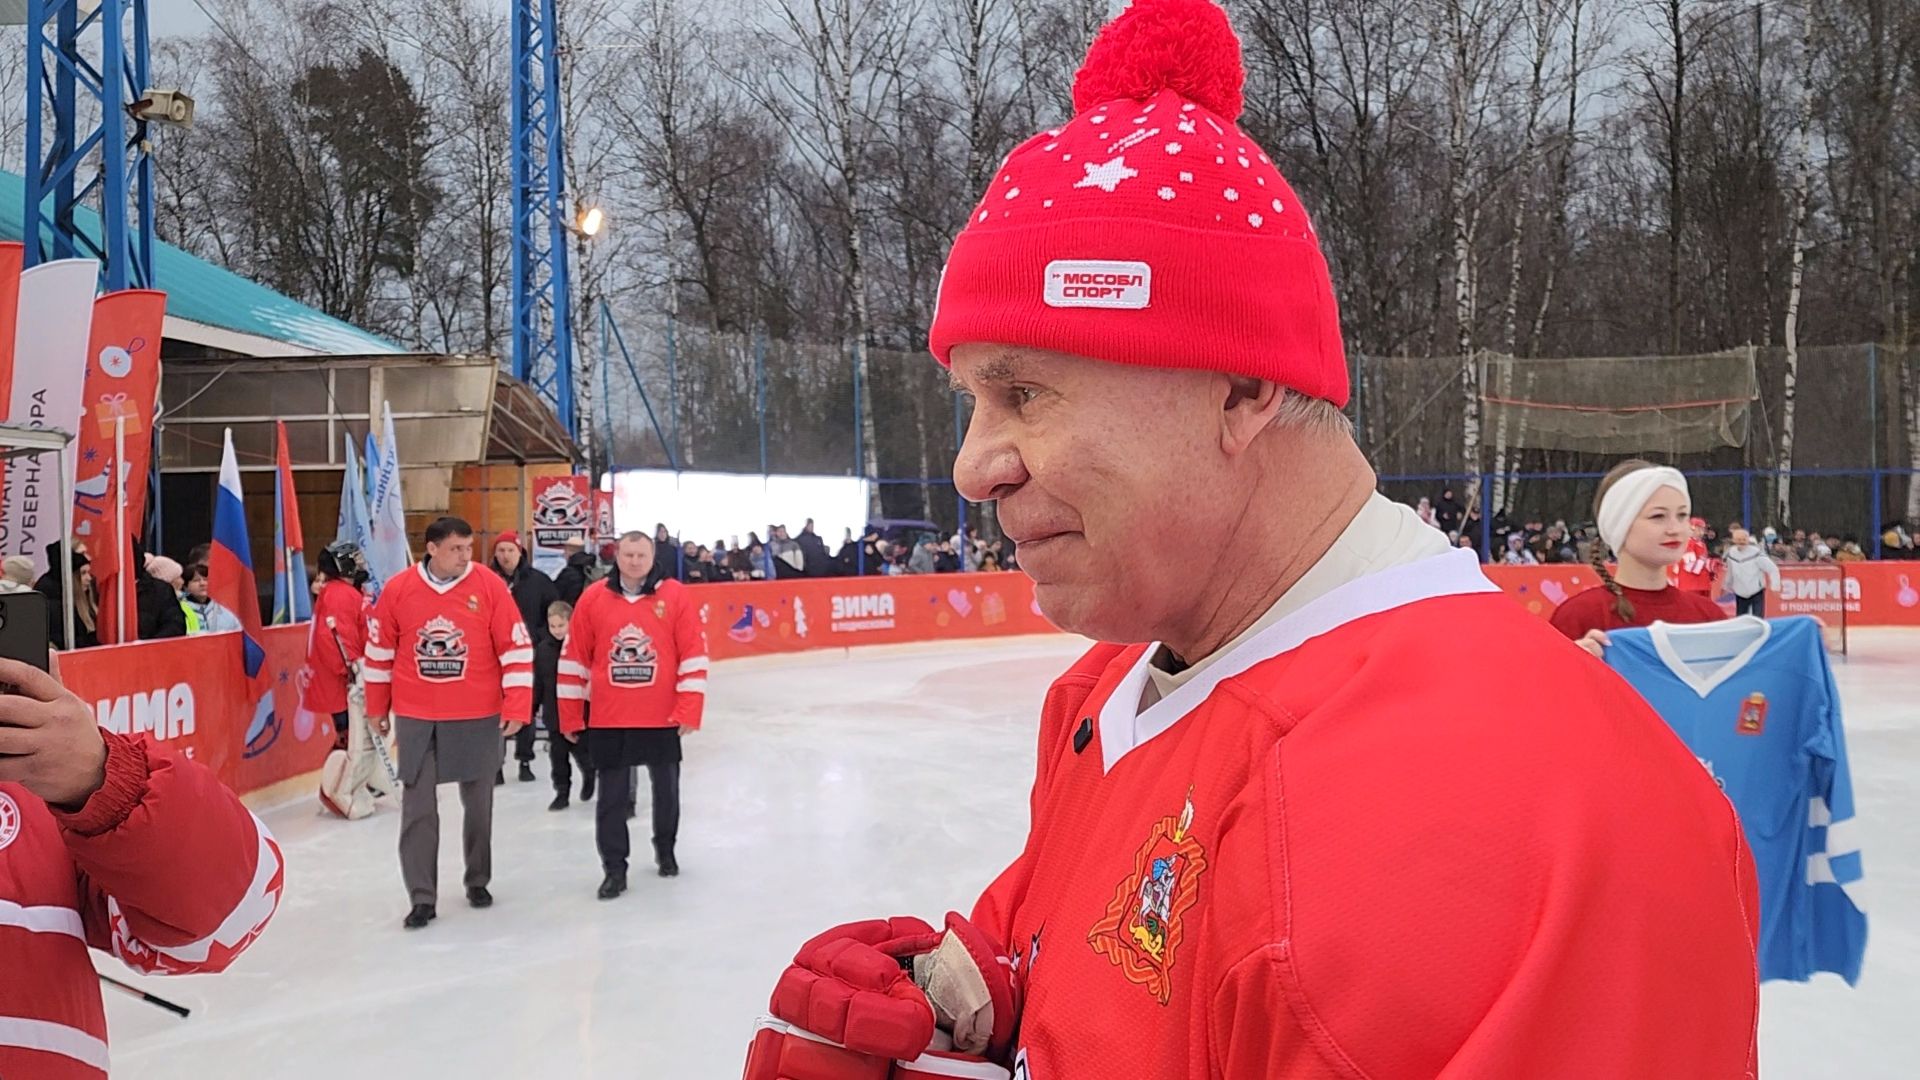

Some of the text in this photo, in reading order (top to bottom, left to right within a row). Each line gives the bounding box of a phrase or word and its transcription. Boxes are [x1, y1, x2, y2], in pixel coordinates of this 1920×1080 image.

[1063, 273, 1143, 287] МОСОБЛ
[1063, 286, 1125, 299] СПОРТ
[19, 388, 47, 556] ГУБЕРНАРА
[1780, 577, 1861, 600] ЗИМА
[831, 593, 895, 620] ЗИМА
[88, 682, 196, 741] ИМА
